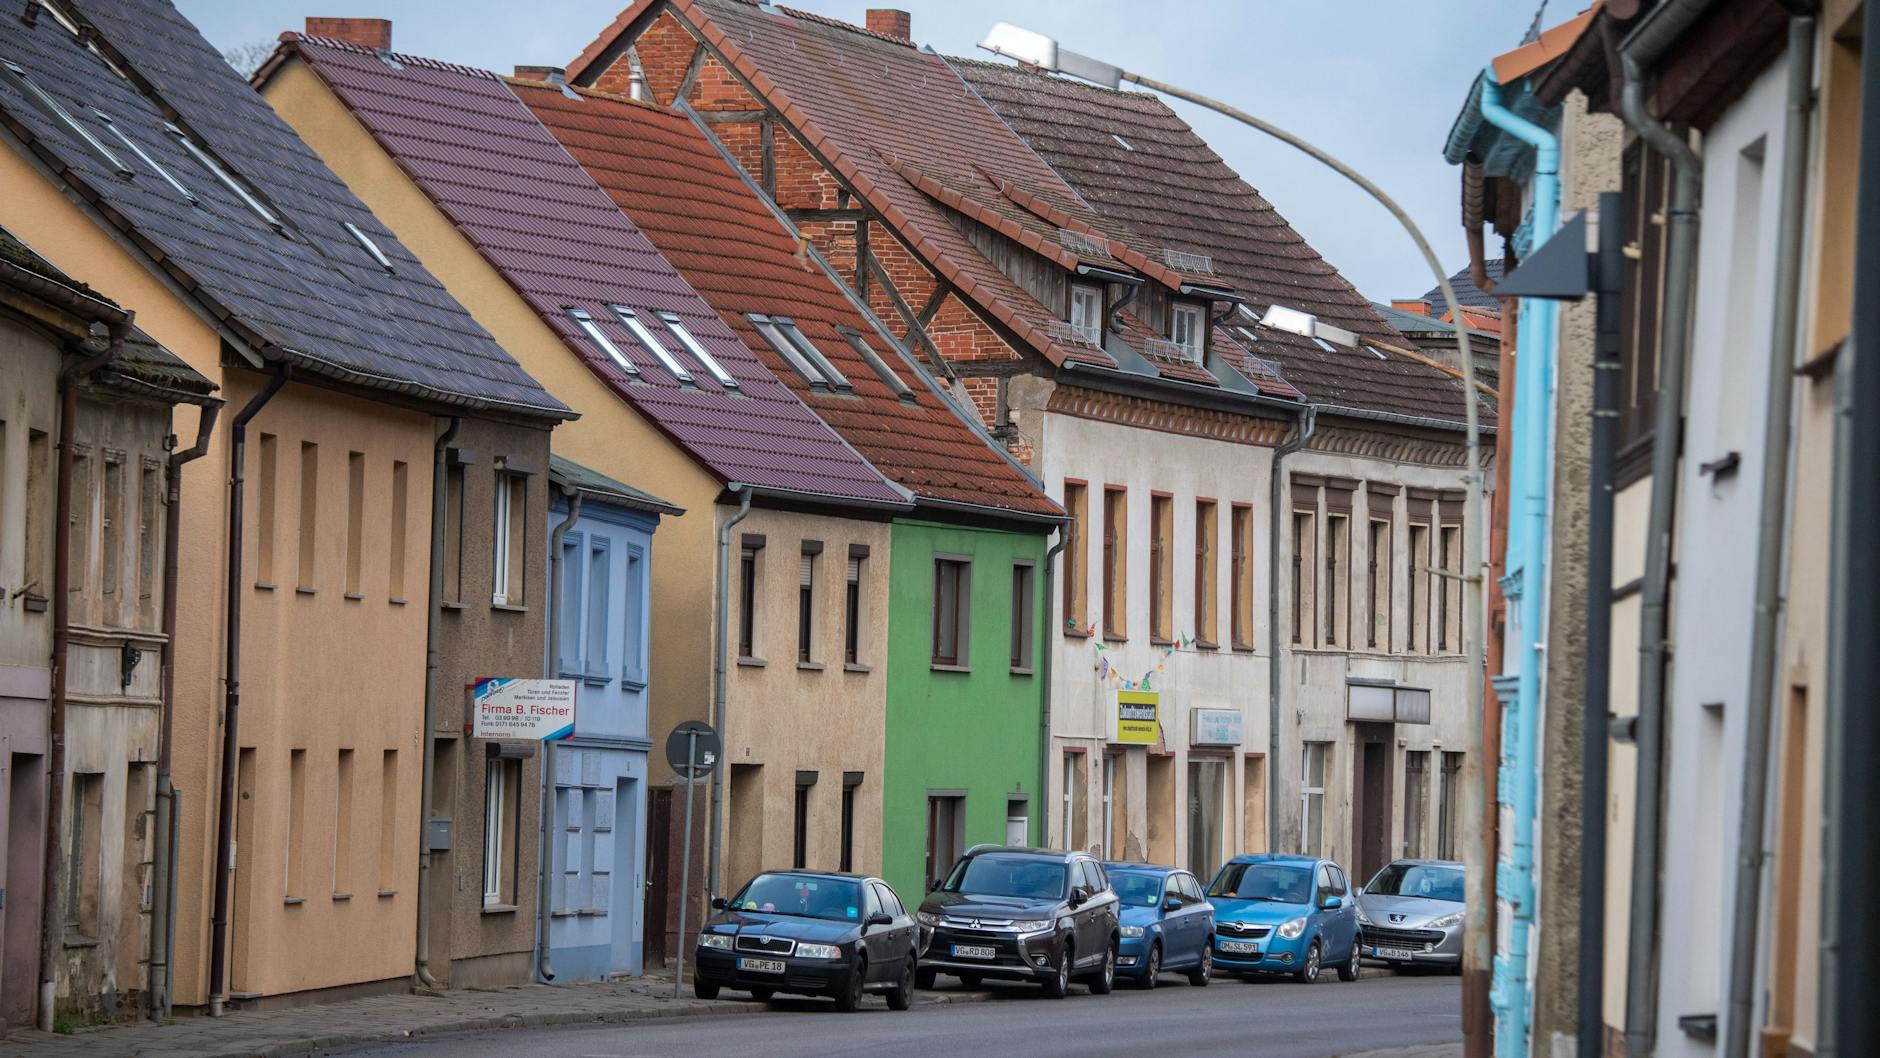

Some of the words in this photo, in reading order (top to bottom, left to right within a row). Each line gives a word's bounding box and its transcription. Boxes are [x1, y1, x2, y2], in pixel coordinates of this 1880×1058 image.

[481, 703, 512, 714] Firma
[516, 704, 527, 715] B.
[530, 705, 570, 716] Fischer
[955, 946, 965, 955] VG
[969, 947, 980, 956] RD
[743, 959, 755, 968] VG
[759, 960, 770, 970] PE
[771, 962, 782, 971] 18
